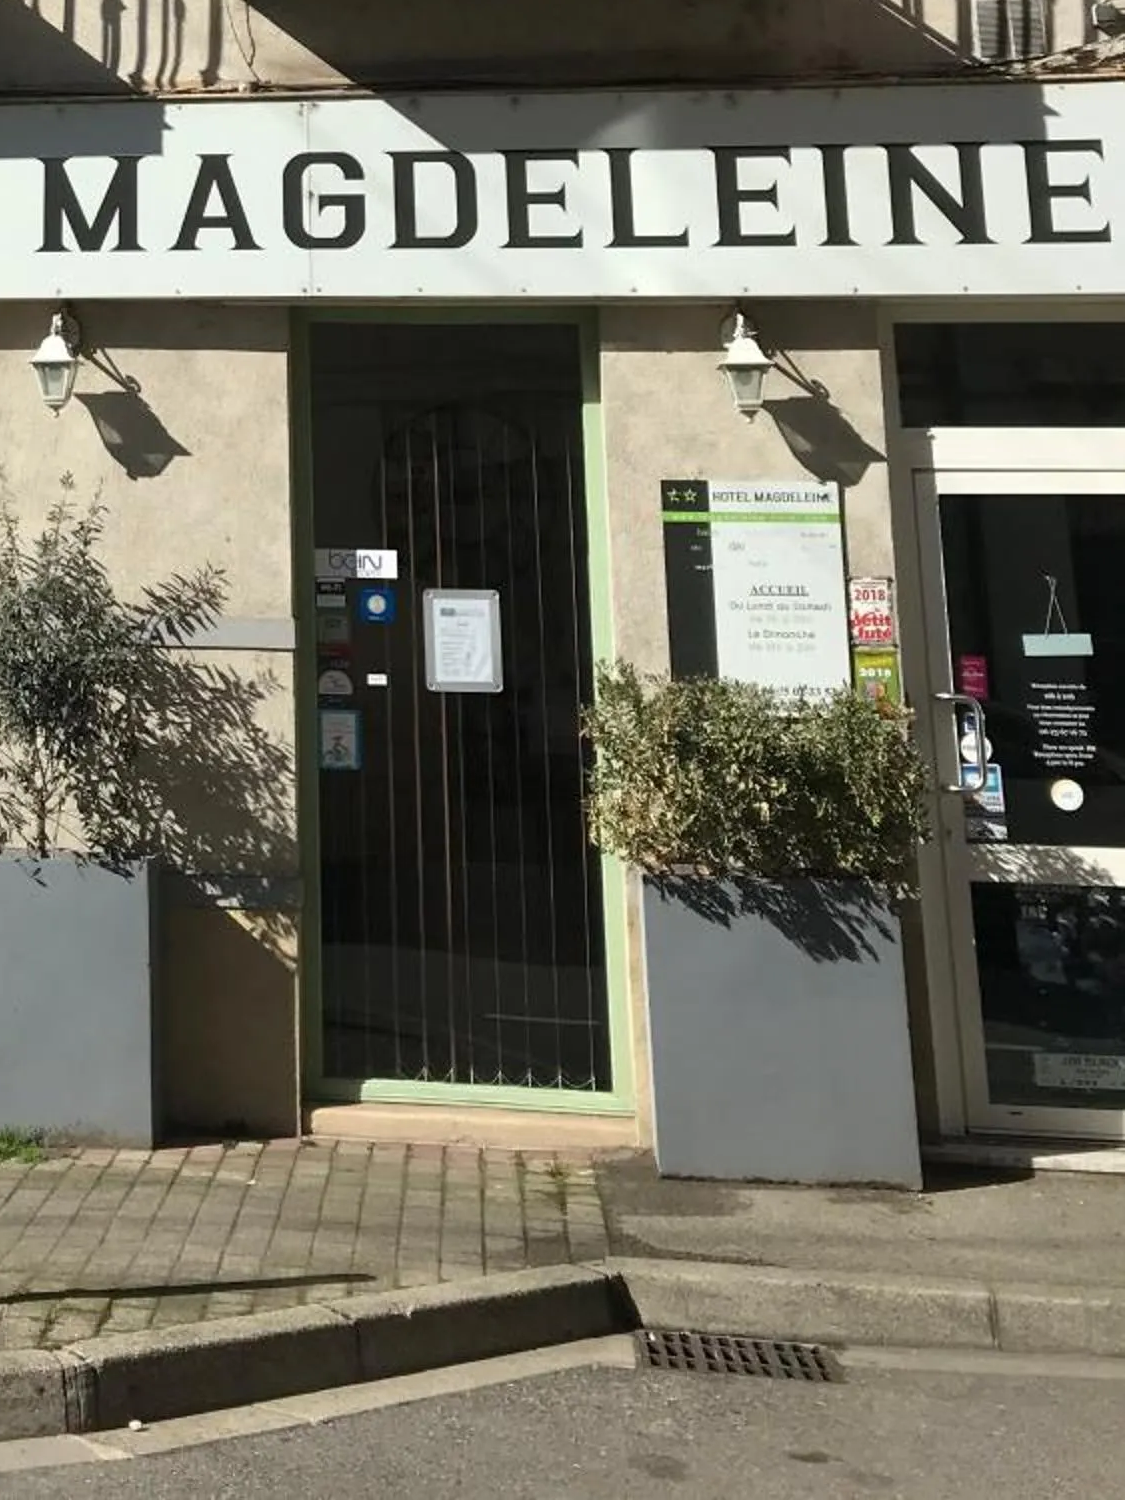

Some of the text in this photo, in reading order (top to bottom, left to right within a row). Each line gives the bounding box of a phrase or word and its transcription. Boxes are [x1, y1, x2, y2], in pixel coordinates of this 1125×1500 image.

[34, 139, 1112, 253] MAGDELEINE
[712, 491, 752, 503] HOTEL
[748, 584, 810, 596] ACCUEIL
[855, 589, 886, 601] 2018
